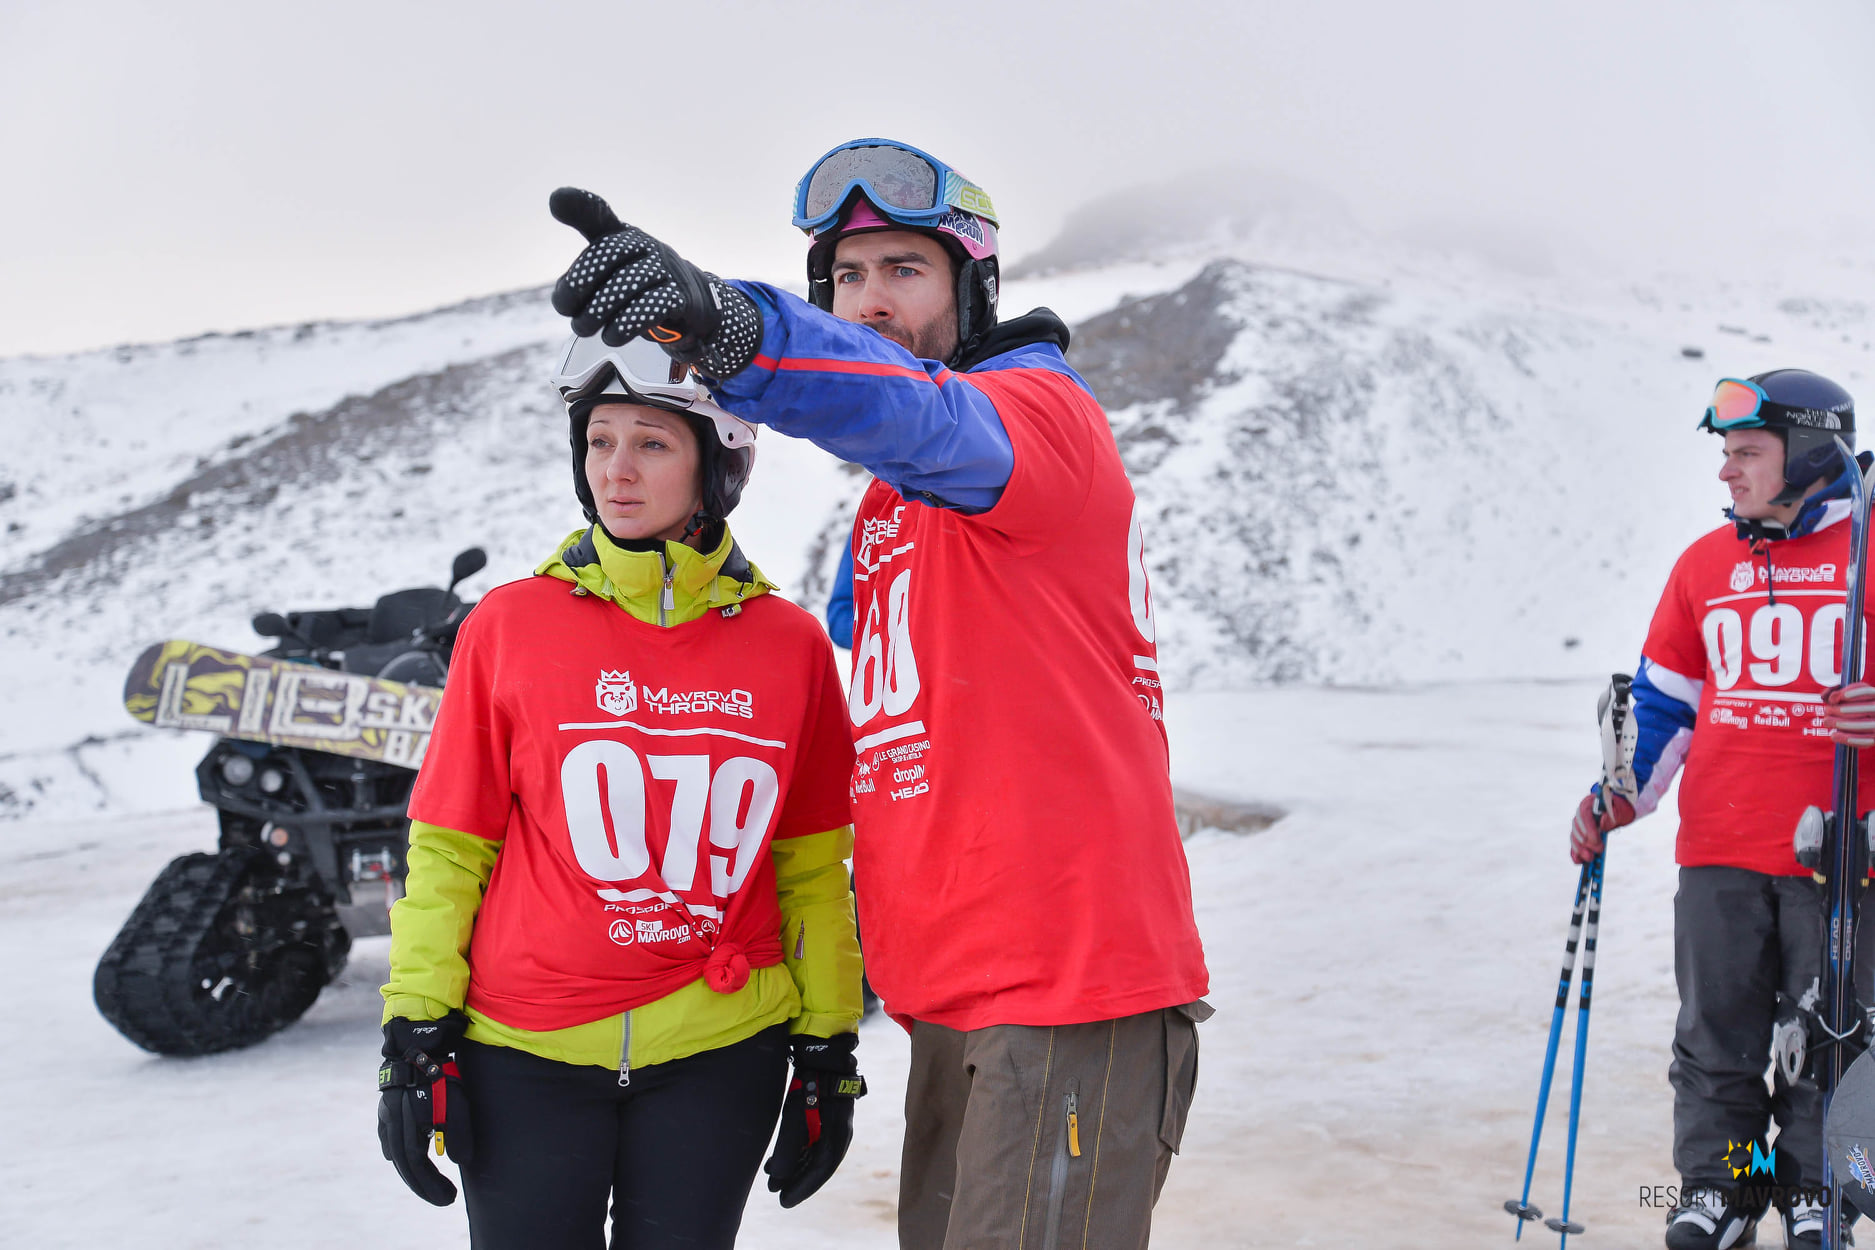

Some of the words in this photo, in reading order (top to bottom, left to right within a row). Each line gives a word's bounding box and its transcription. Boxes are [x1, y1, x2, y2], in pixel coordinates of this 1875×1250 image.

[1702, 603, 1867, 691] 090
[644, 700, 754, 719] THRONES
[560, 740, 780, 898] 079
[637, 924, 690, 944] MAVROVO
